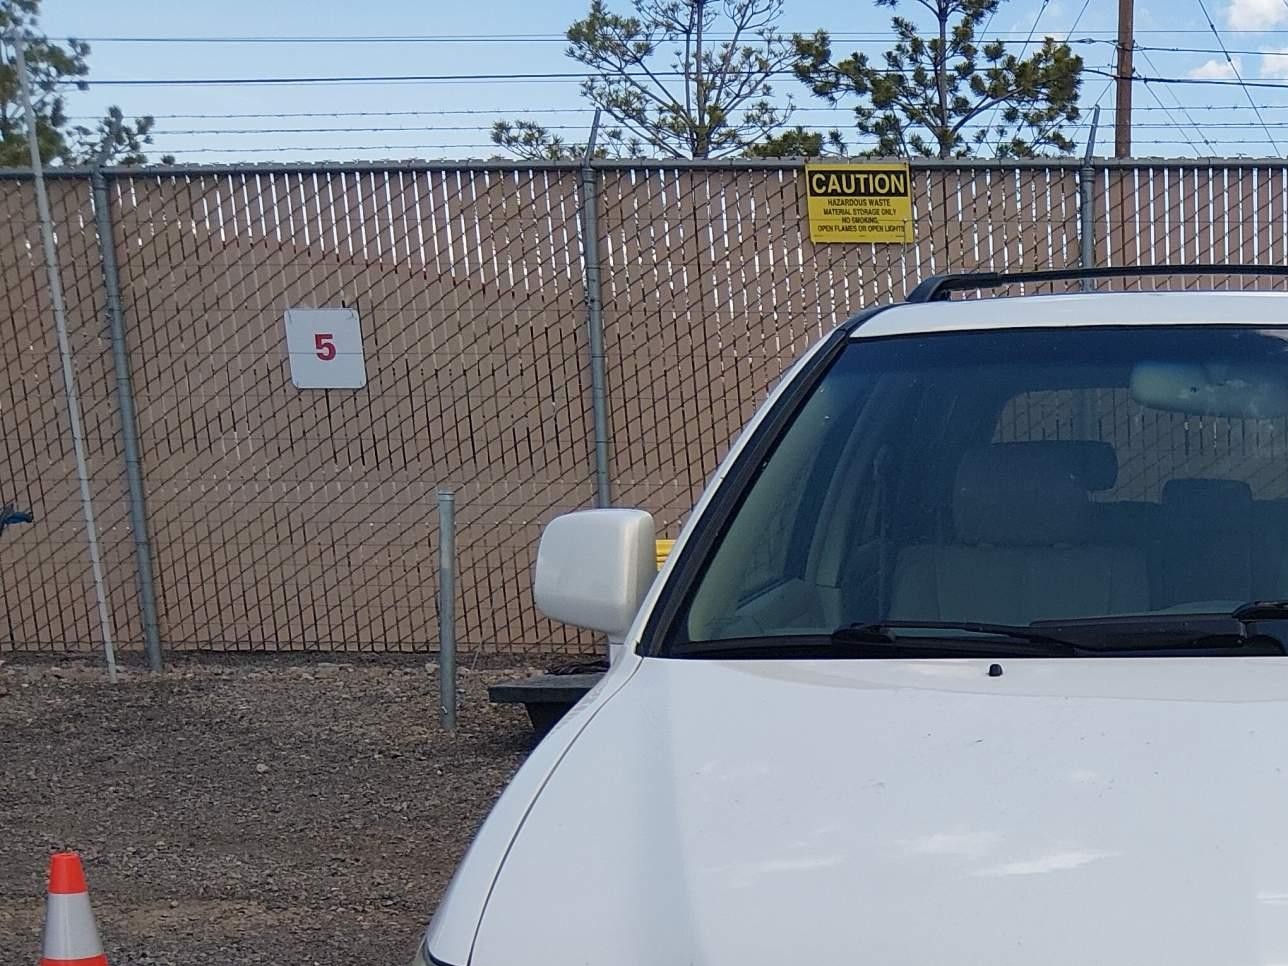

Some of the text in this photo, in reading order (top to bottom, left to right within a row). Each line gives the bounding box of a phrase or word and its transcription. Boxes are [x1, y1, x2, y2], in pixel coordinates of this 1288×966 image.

[812, 173, 905, 194] CAUTION
[828, 198, 891, 207] HAZARDOUS WASTE
[823, 208, 897, 216] MATERIAL STORAGE ONLY
[868, 225, 884, 233] OPEN
[884, 225, 905, 233] LIGHTS
[315, 333, 337, 361] 5
